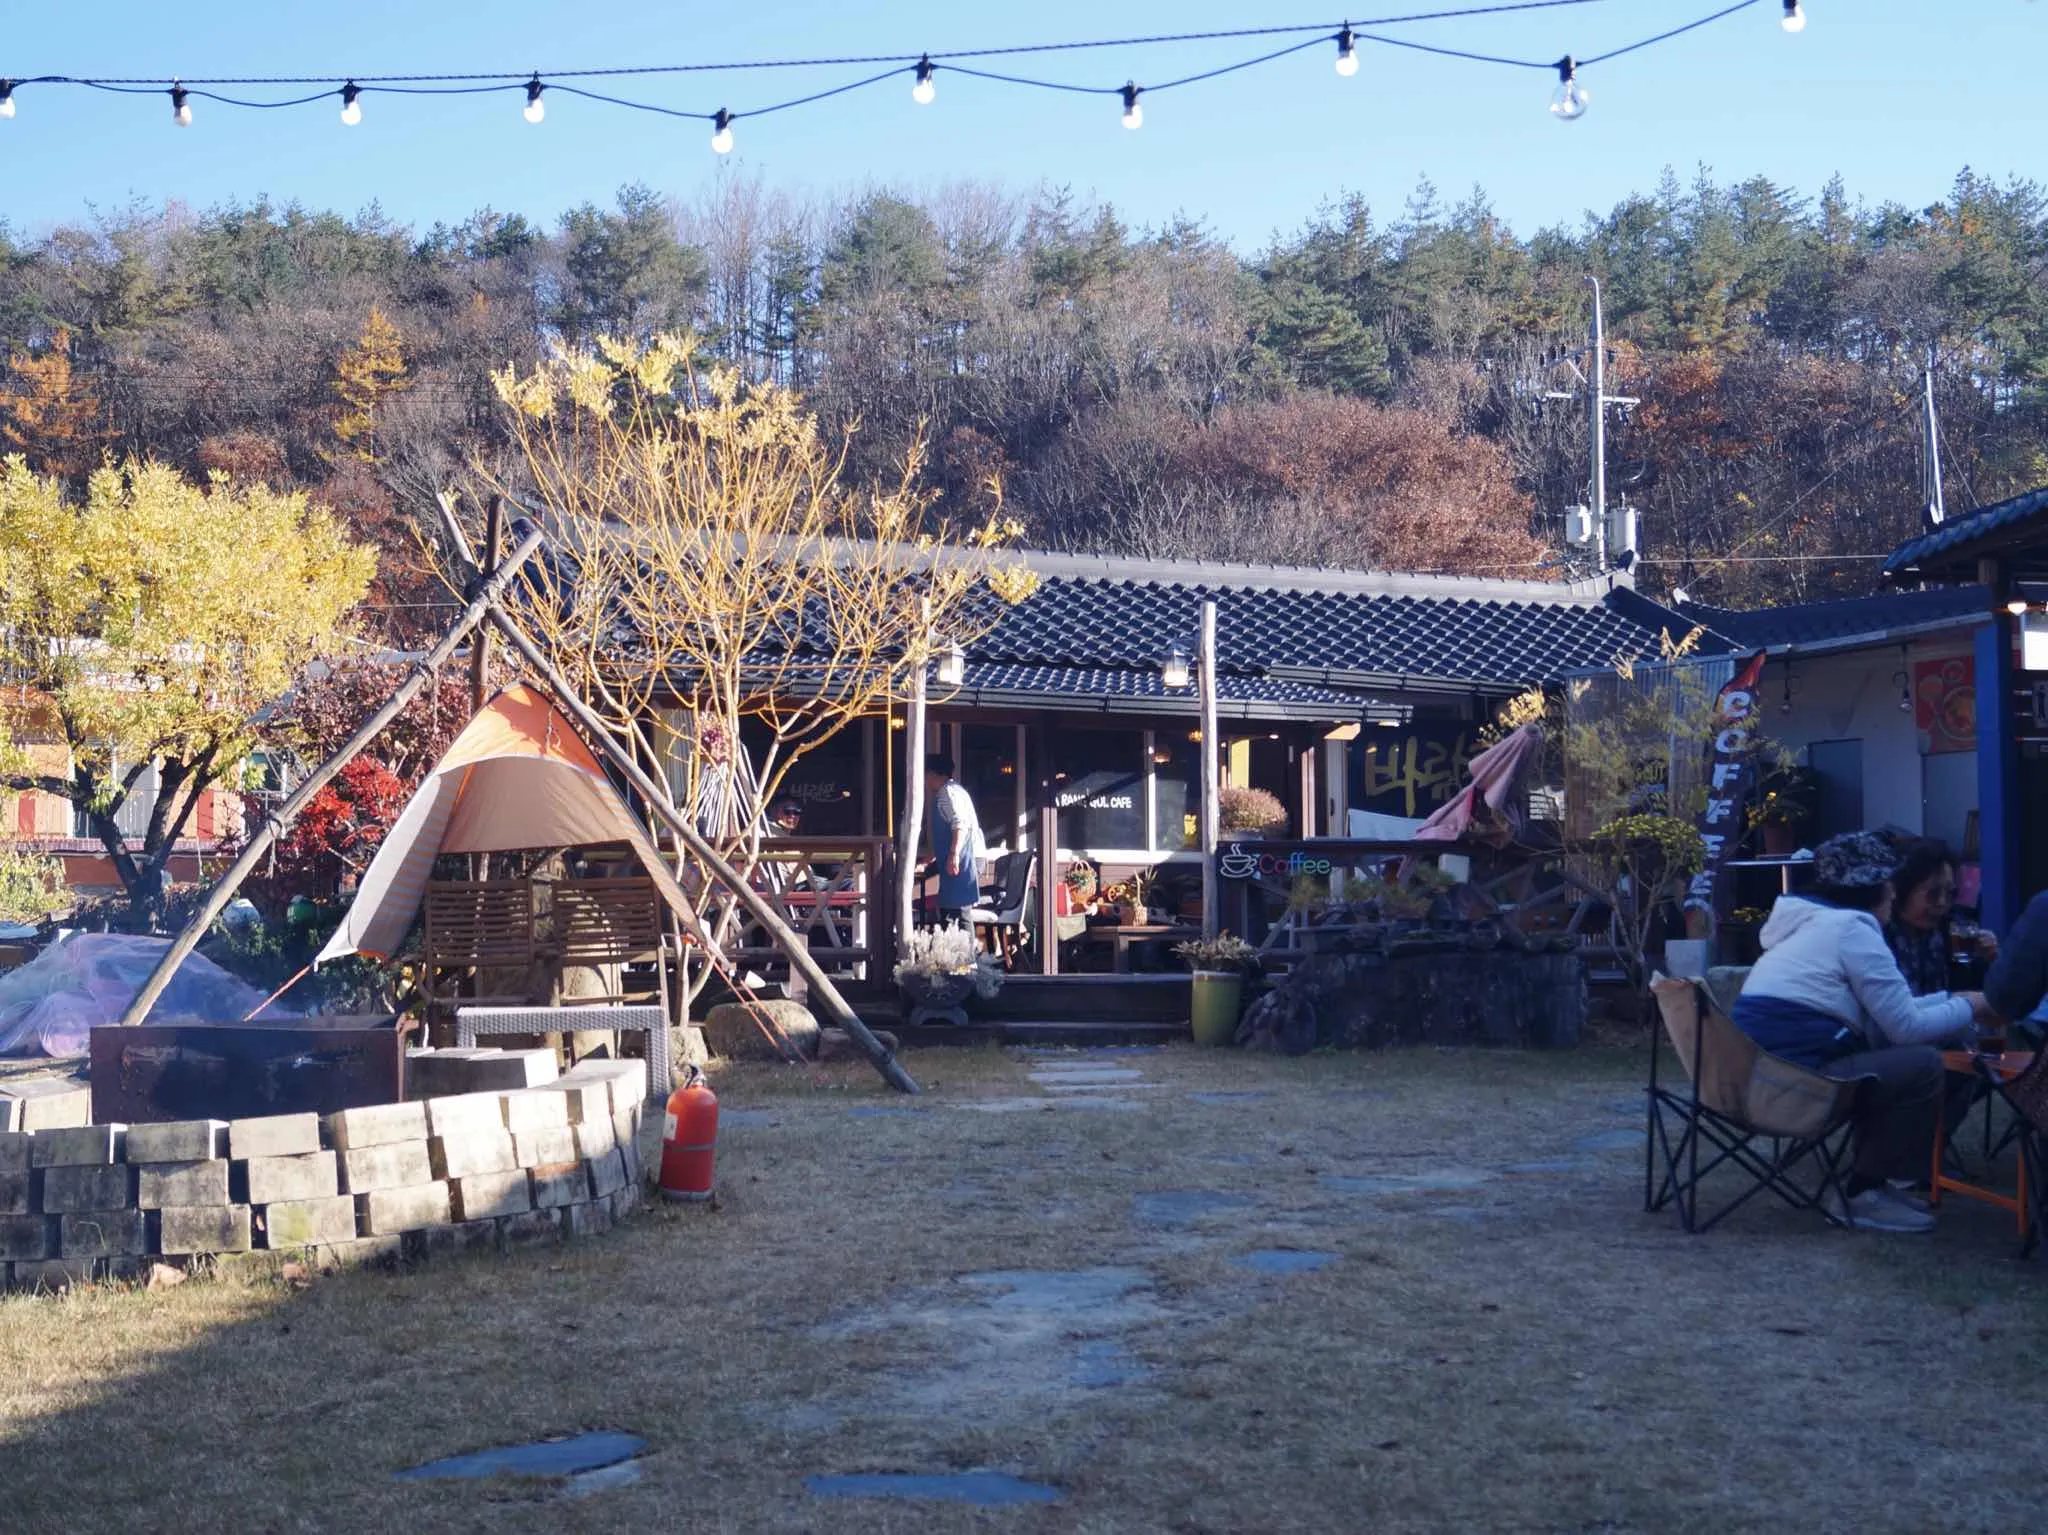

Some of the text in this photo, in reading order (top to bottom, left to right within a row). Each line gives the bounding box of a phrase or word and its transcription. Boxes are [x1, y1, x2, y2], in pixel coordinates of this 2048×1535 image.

[1110, 796, 1132, 808] CAFE
[1688, 691, 1751, 894] COFFEE
[1260, 852, 1330, 874] Coffee
